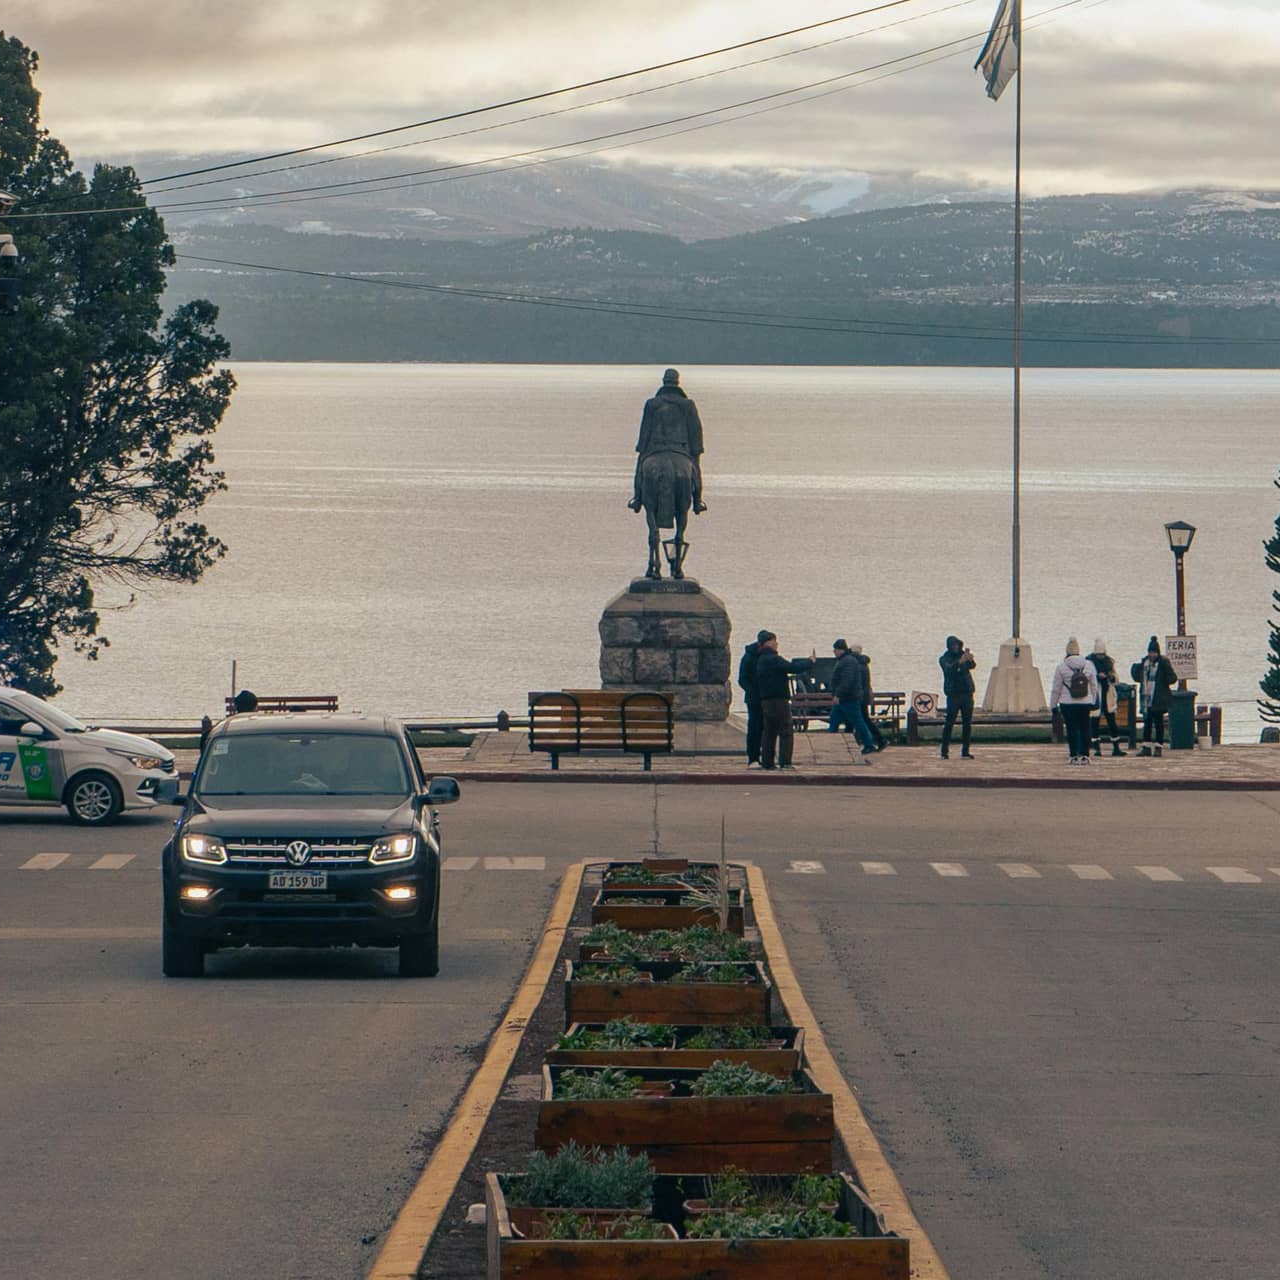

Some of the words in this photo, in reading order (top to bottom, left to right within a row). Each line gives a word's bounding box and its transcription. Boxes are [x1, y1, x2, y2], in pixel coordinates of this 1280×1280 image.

[1167, 641, 1195, 650] FERIA
[289, 876, 308, 888] 159
[311, 876, 325, 888] UP
